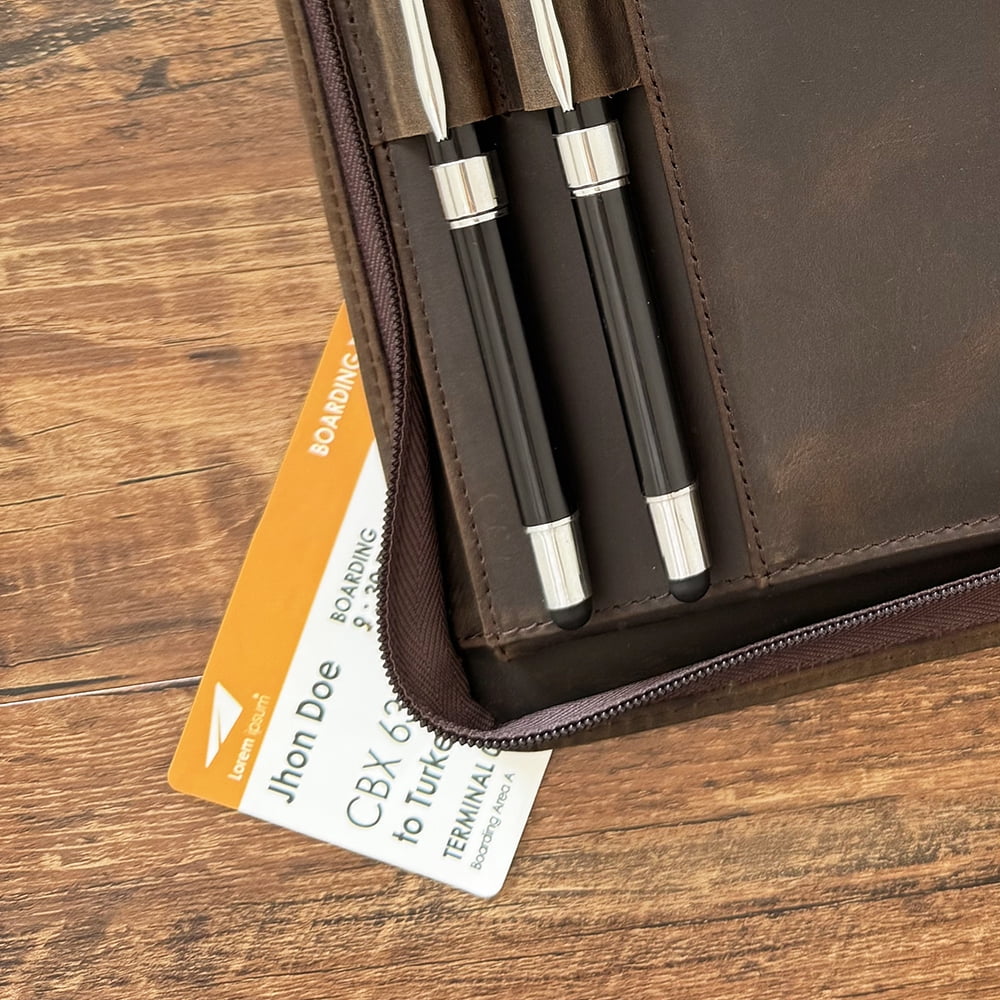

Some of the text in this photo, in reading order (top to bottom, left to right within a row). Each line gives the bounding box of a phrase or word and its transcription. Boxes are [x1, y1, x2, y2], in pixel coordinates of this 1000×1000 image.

[308, 352, 360, 457] BOARDING
[330, 528, 377, 623] BOARDING
[227, 737, 256, 782] Lorem
[268, 660, 341, 804] Jhon Doe
[346, 748, 402, 828] CBX
[392, 816, 423, 844] to
[443, 764, 495, 859] TERMINAL
[470, 773, 516, 870] Boarding Area A
